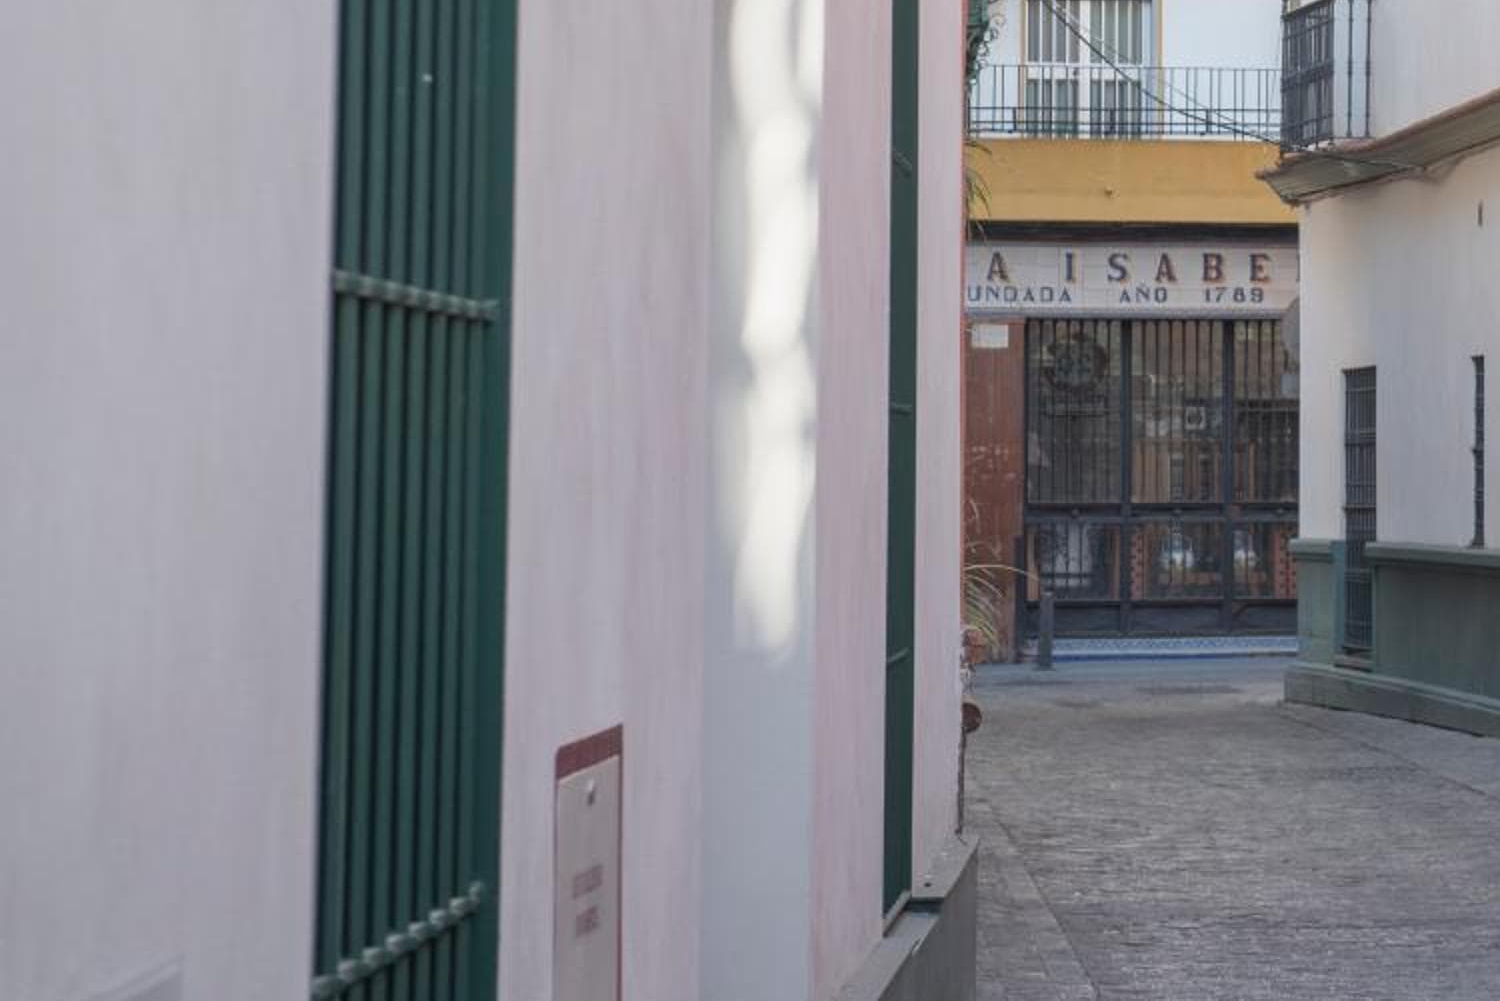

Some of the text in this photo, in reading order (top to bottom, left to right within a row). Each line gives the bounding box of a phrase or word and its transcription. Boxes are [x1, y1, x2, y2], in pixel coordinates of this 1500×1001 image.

[1064, 252, 1300, 283] ISABE
[1119, 284, 1168, 303] AÑO
[1204, 286, 1265, 303] 1789
